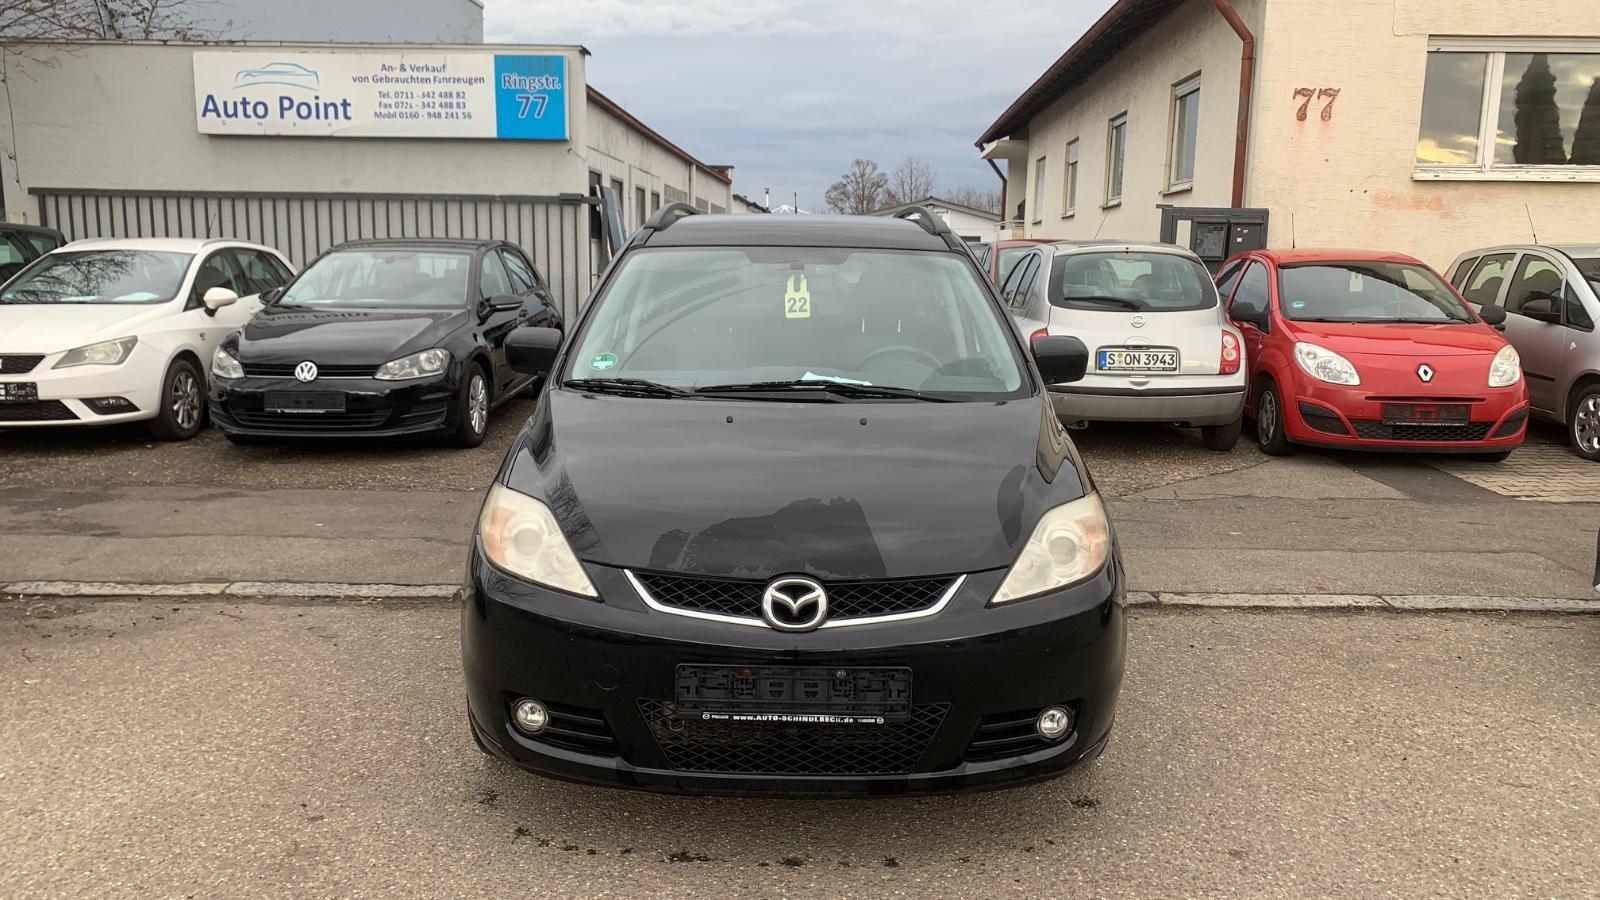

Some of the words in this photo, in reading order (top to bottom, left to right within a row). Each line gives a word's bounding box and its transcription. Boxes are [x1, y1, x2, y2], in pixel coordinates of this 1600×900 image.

[380, 63, 397, 73] An-
[399, 64, 407, 73] &
[409, 64, 447, 73] Verkauf
[352, 75, 370, 83] von
[372, 75, 431, 84] Gebrauchten
[502, 73, 561, 93] Ringstr.
[378, 91, 392, 99] Tel.
[394, 91, 414, 99] 0711
[438, 91, 454, 99] 488
[455, 91, 466, 99] 82
[201, 94, 269, 119] Auto
[279, 96, 352, 120] Point
[379, 101, 392, 109] Fax
[421, 101, 437, 109] 342
[438, 101, 454, 109] 488
[455, 101, 466, 109] 83
[516, 95, 548, 118] 77
[1292, 87, 1341, 122] 77
[398, 112, 419, 120] 0160
[426, 112, 443, 121] 948
[444, 112, 460, 120] 241
[461, 112, 472, 120] 56
[787, 297, 808, 313] 22
[1107, 353, 1116, 366] S
[1124, 353, 1141, 366] ON
[1143, 353, 1175, 366] 3943
